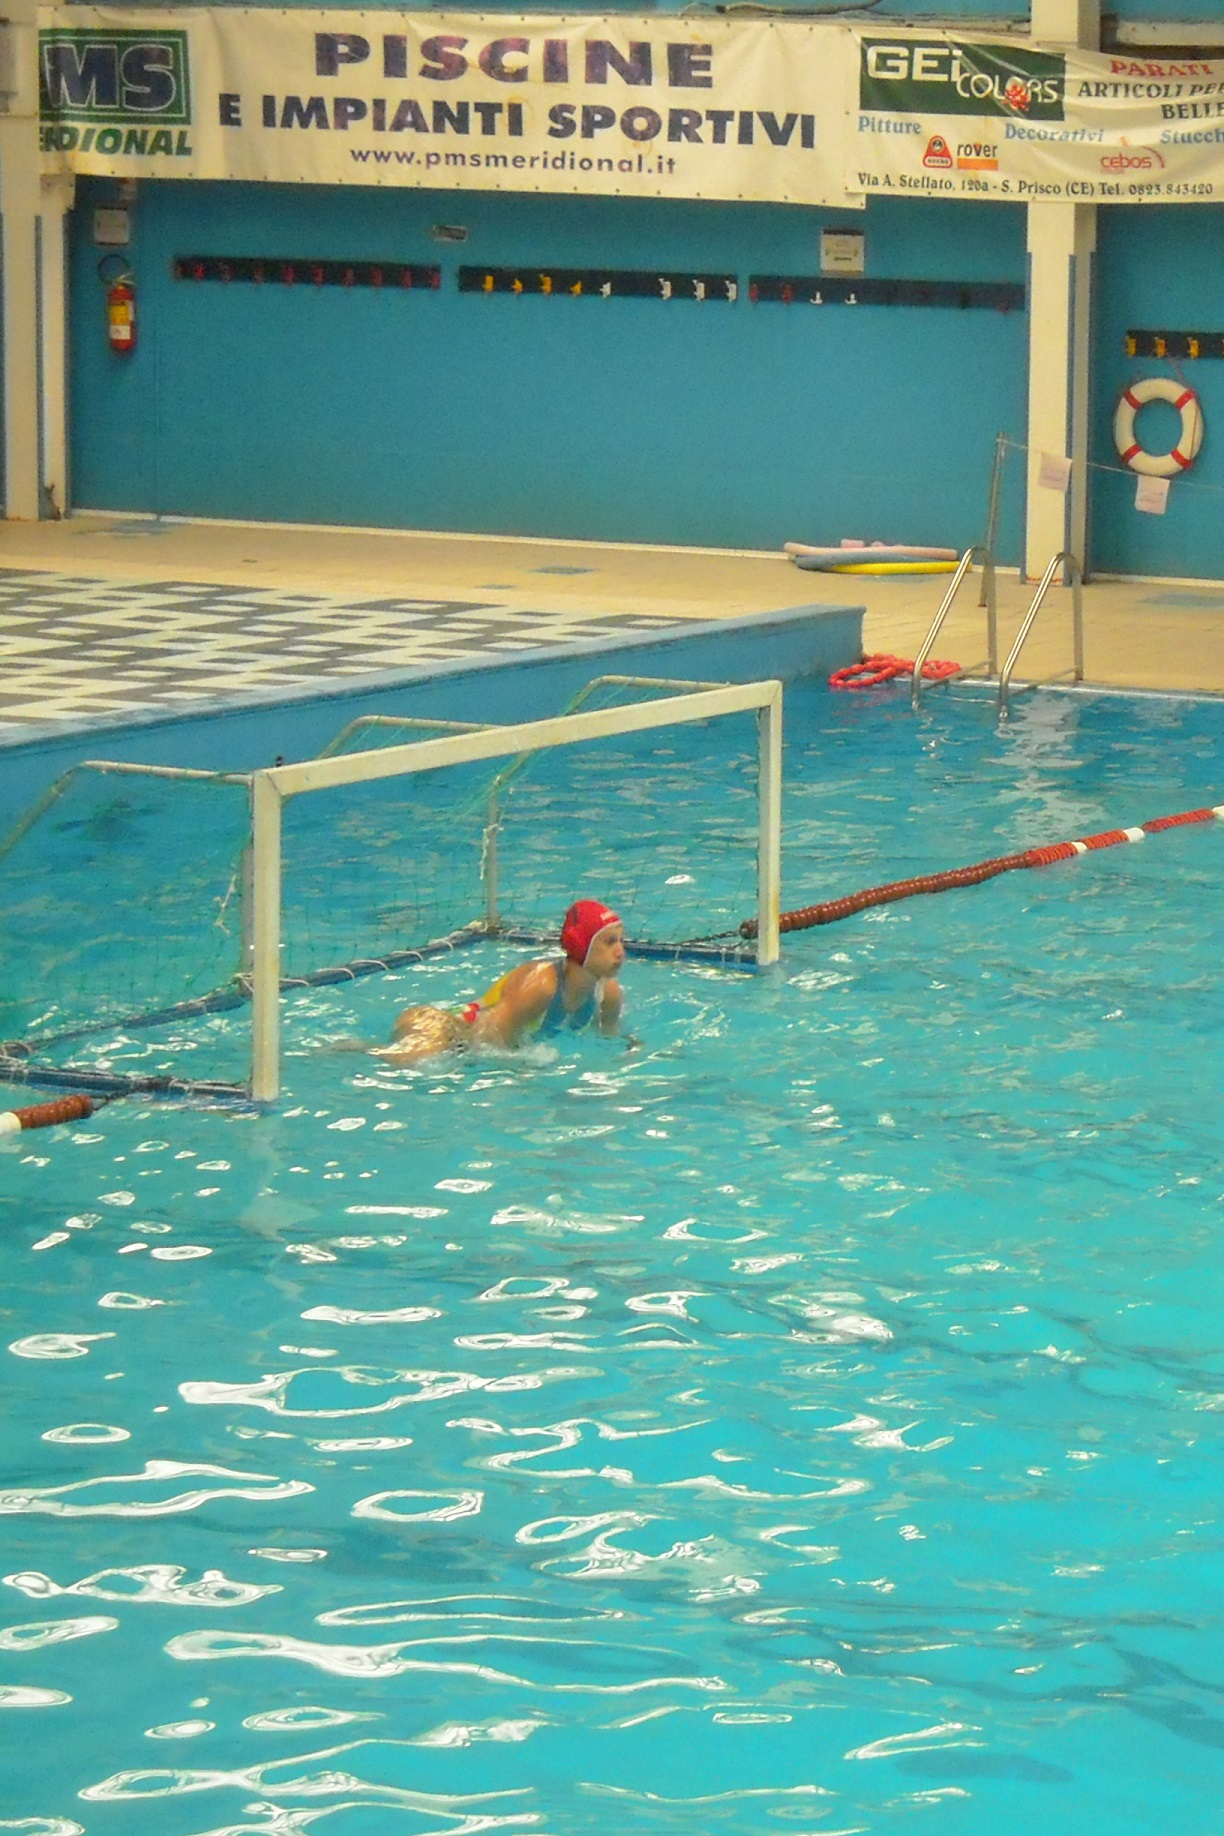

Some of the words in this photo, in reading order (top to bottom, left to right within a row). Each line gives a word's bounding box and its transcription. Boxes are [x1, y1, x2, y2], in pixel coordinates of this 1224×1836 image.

[315, 33, 713, 88] PISCINE
[1110, 60, 1214, 76] PARATI
[1078, 81, 1184, 98] ARTICOLI
[219, 92, 242, 127] E
[262, 95, 523, 138] IMPIANTI
[547, 103, 816, 149] SPORTIVI
[857, 115, 922, 135] Pitture
[1005, 123, 1105, 143] Decorativi
[956, 143, 998, 158] rover
[350, 149, 677, 175] www.pmsmeridional.it
[1100, 153, 1153, 169] cebos
[857, 172, 879, 187] Via
[882, 174, 896, 187] A.
[961, 179, 990, 191] 120a
[1001, 179, 1014, 193] S.
[1018, 182, 1062, 195] Prisco
[1065, 182, 1095, 197] (CE)
[1098, 182, 1125, 196] Tel.
